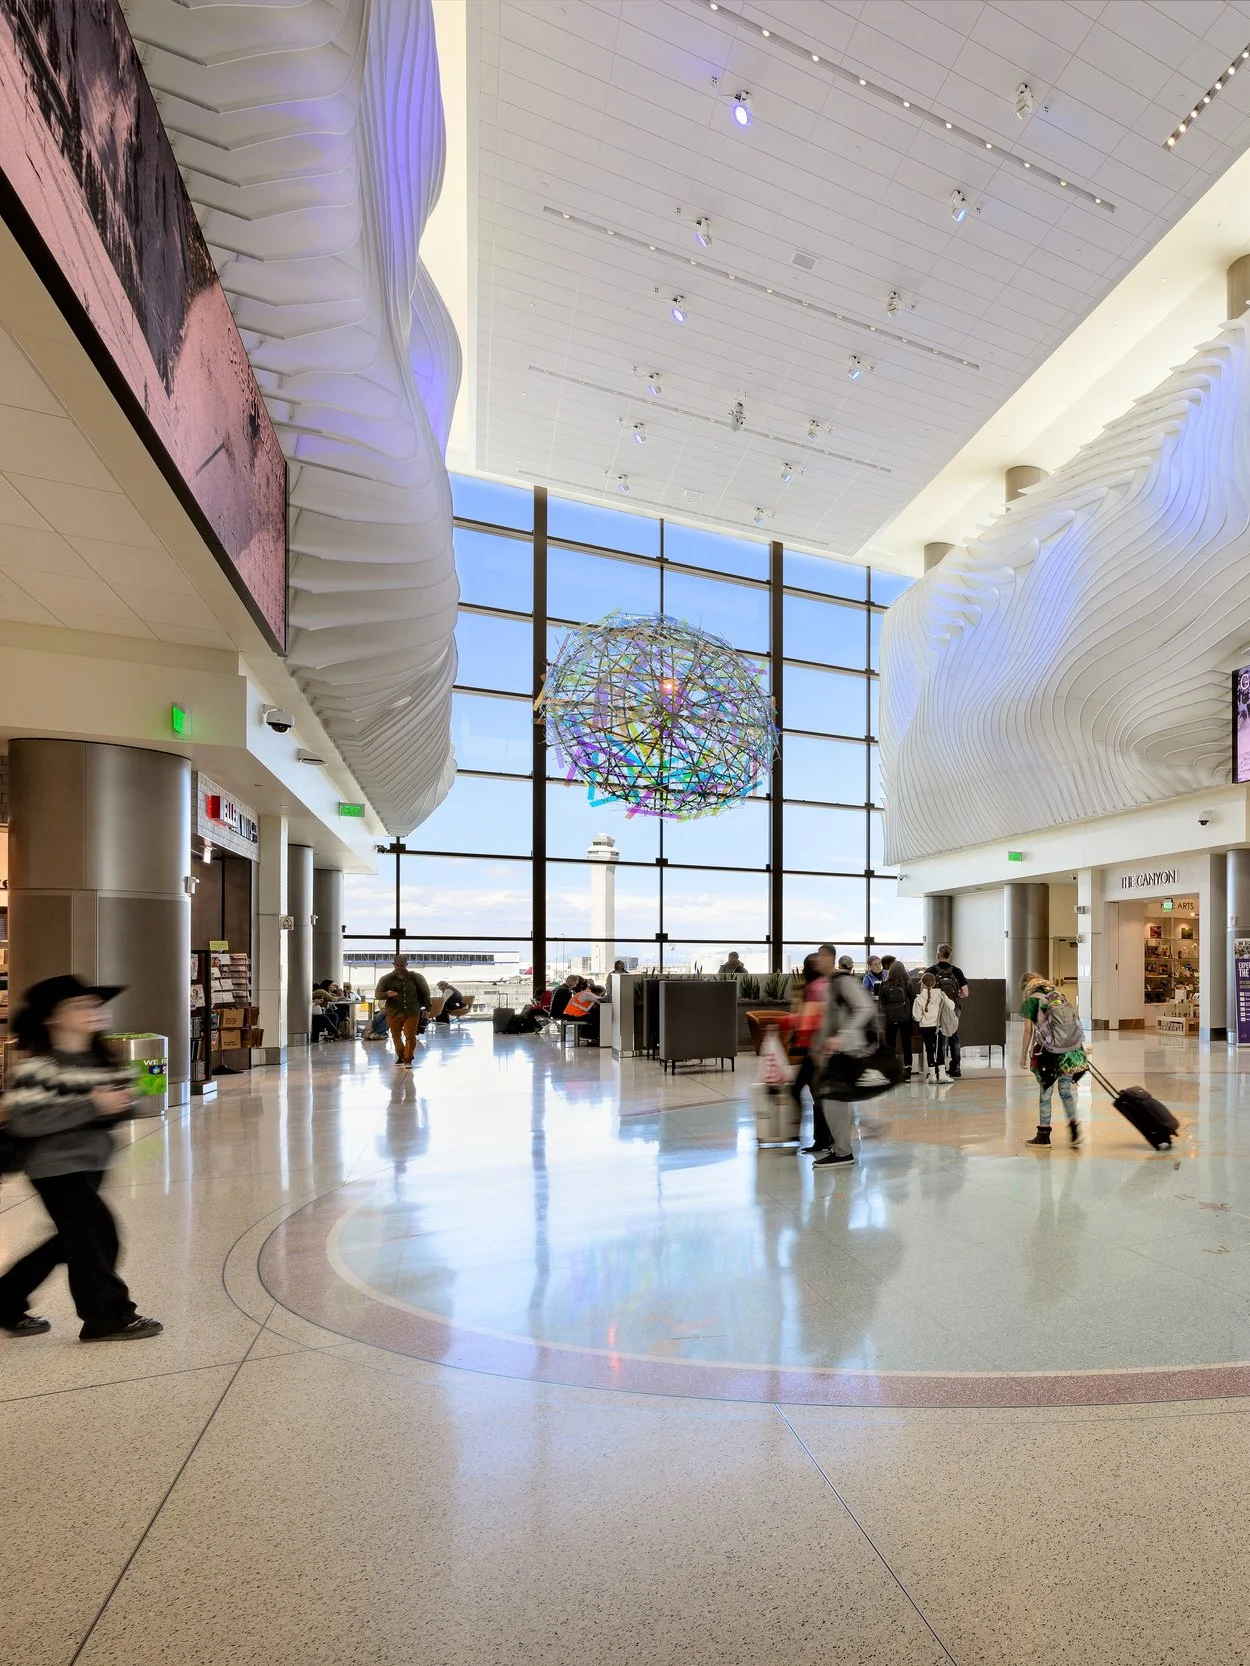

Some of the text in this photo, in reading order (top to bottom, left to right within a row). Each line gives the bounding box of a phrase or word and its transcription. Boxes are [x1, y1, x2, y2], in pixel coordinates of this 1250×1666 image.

[1121, 869, 1176, 889] THE CANYON
[1177, 902, 1194, 910] ARTS
[1240, 968, 1250, 978] THE
